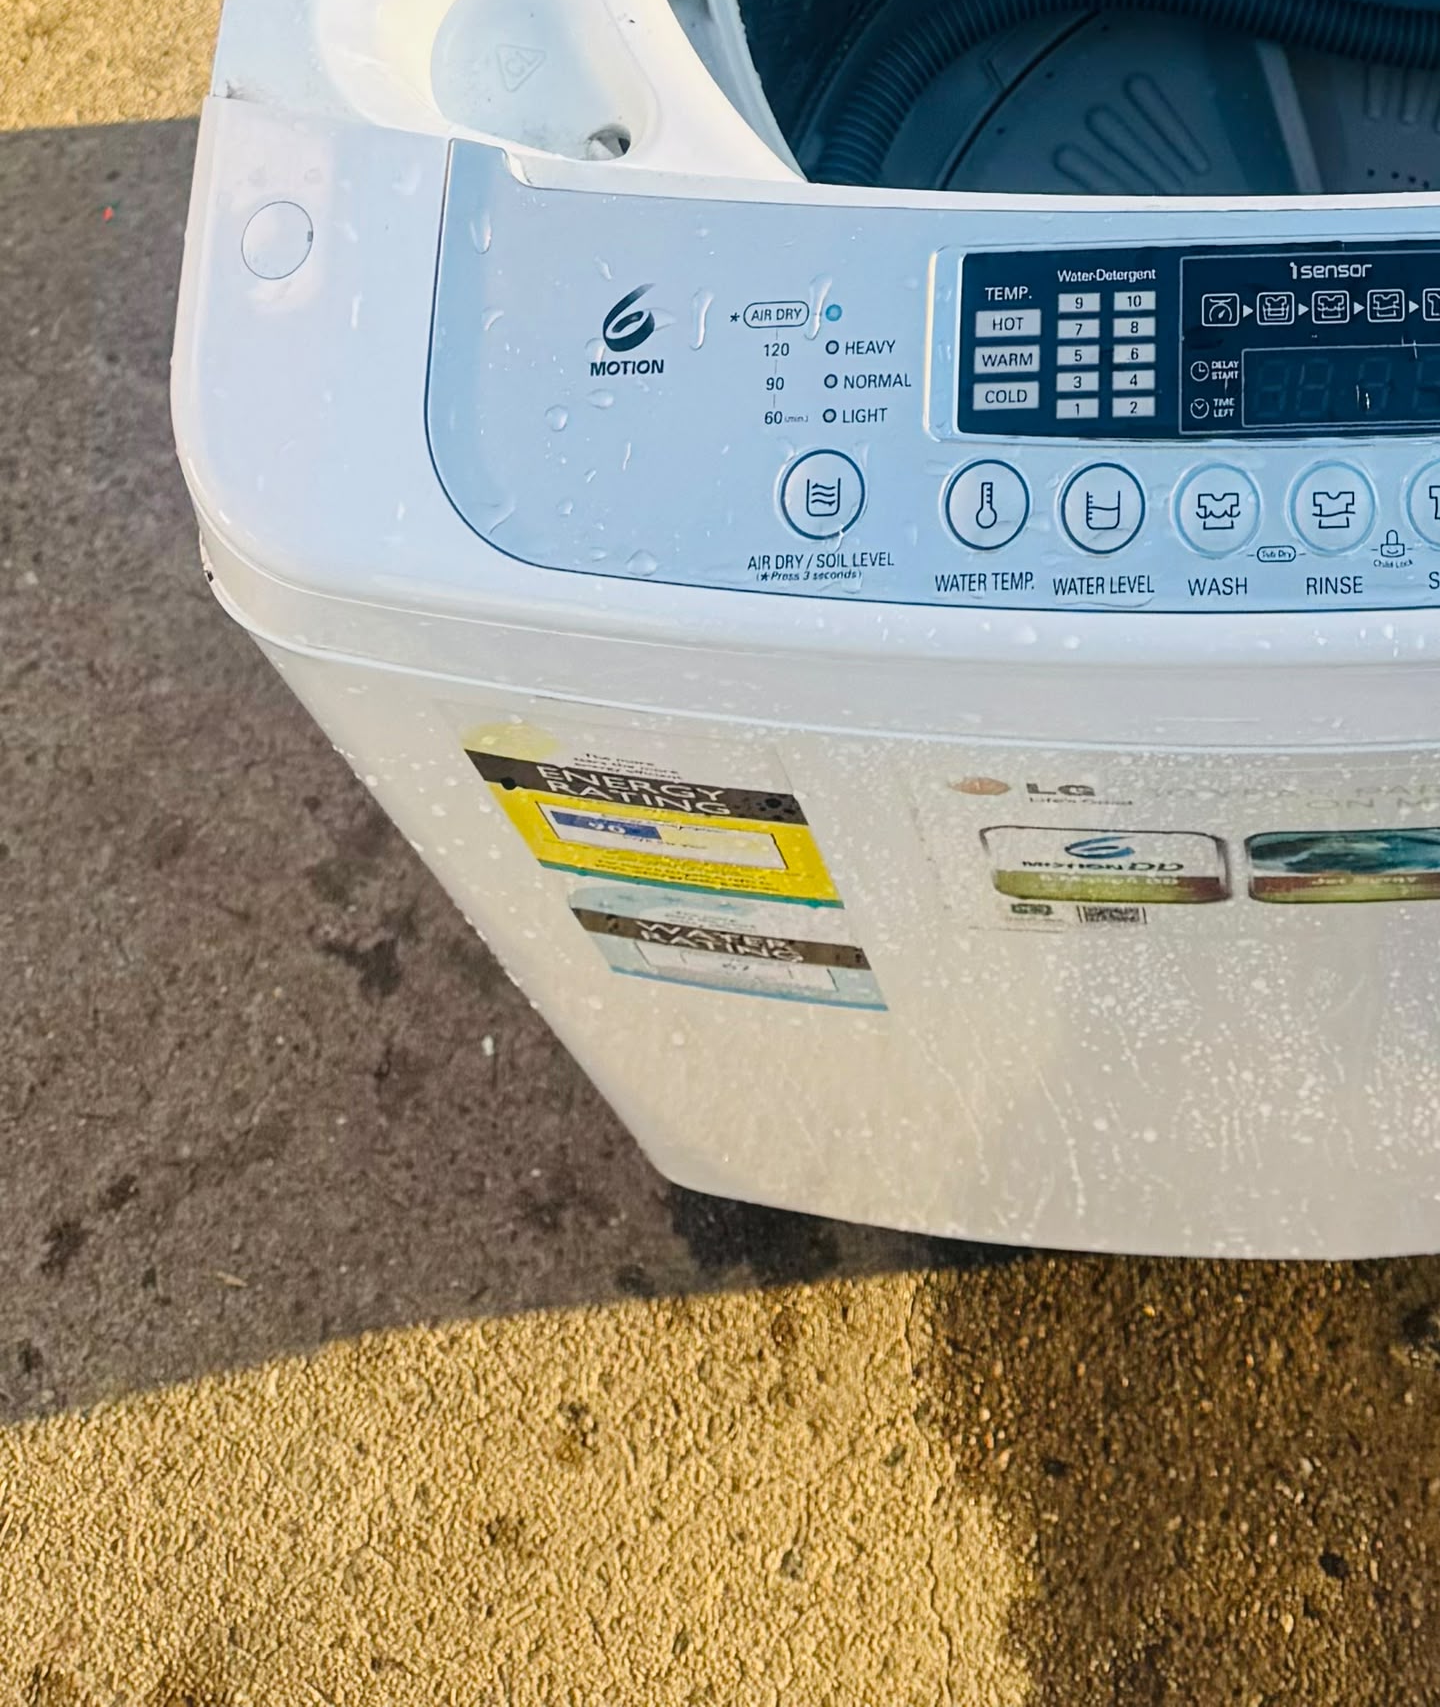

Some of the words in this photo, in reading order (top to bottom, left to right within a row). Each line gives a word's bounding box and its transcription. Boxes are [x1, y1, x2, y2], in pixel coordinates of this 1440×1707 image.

[984, 285, 1033, 302] TEMP.
[1074, 297, 1084, 310] 9
[1127, 295, 1142, 308] 10
[750, 308, 772, 322] AIR
[776, 307, 803, 321] DRY
[992, 317, 1024, 332] HOT
[1074, 323, 1083, 336] 7
[1130, 321, 1139, 334] 8
[763, 342, 790, 357] 120
[844, 339, 896, 355] HEAVY
[1130, 347, 1139, 361] 6
[982, 352, 1034, 368] WARM
[1074, 349, 1083, 362] 5
[590, 358, 665, 377] MOTION
[1211, 360, 1239, 370] DELAY
[843, 373, 912, 390] NORMAL
[1073, 376, 1082, 389] 3
[1129, 374, 1139, 387] 4
[1211, 370, 1239, 380] START
[765, 376, 785, 392] 90
[984, 389, 1028, 405] COLD
[1213, 397, 1236, 407] TIME
[841, 407, 888, 424] LIGHT
[1074, 403, 1081, 416] 1
[1129, 401, 1138, 415] 2
[1213, 408, 1235, 418] LEFT
[764, 410, 783, 425] 60
[747, 554, 771, 571] AIR
[775, 553, 804, 570] DRY
[816, 552, 848, 569] SOIL
[852, 551, 895, 568] LEVEL
[803, 570, 811, 581] 3
[935, 573, 988, 593] WATER
[991, 571, 1035, 591] TEMP.
[1053, 576, 1105, 596] WATER
[1109, 575, 1155, 594] LEVEL
[1187, 576, 1249, 597] WASH
[1305, 574, 1364, 595] RINSE
[536, 765, 727, 802] ENERGY
[1026, 782, 1096, 797] LG
[546, 780, 731, 816] RATING
[636, 920, 794, 950] WATER
[640, 930, 805, 963] RATING
